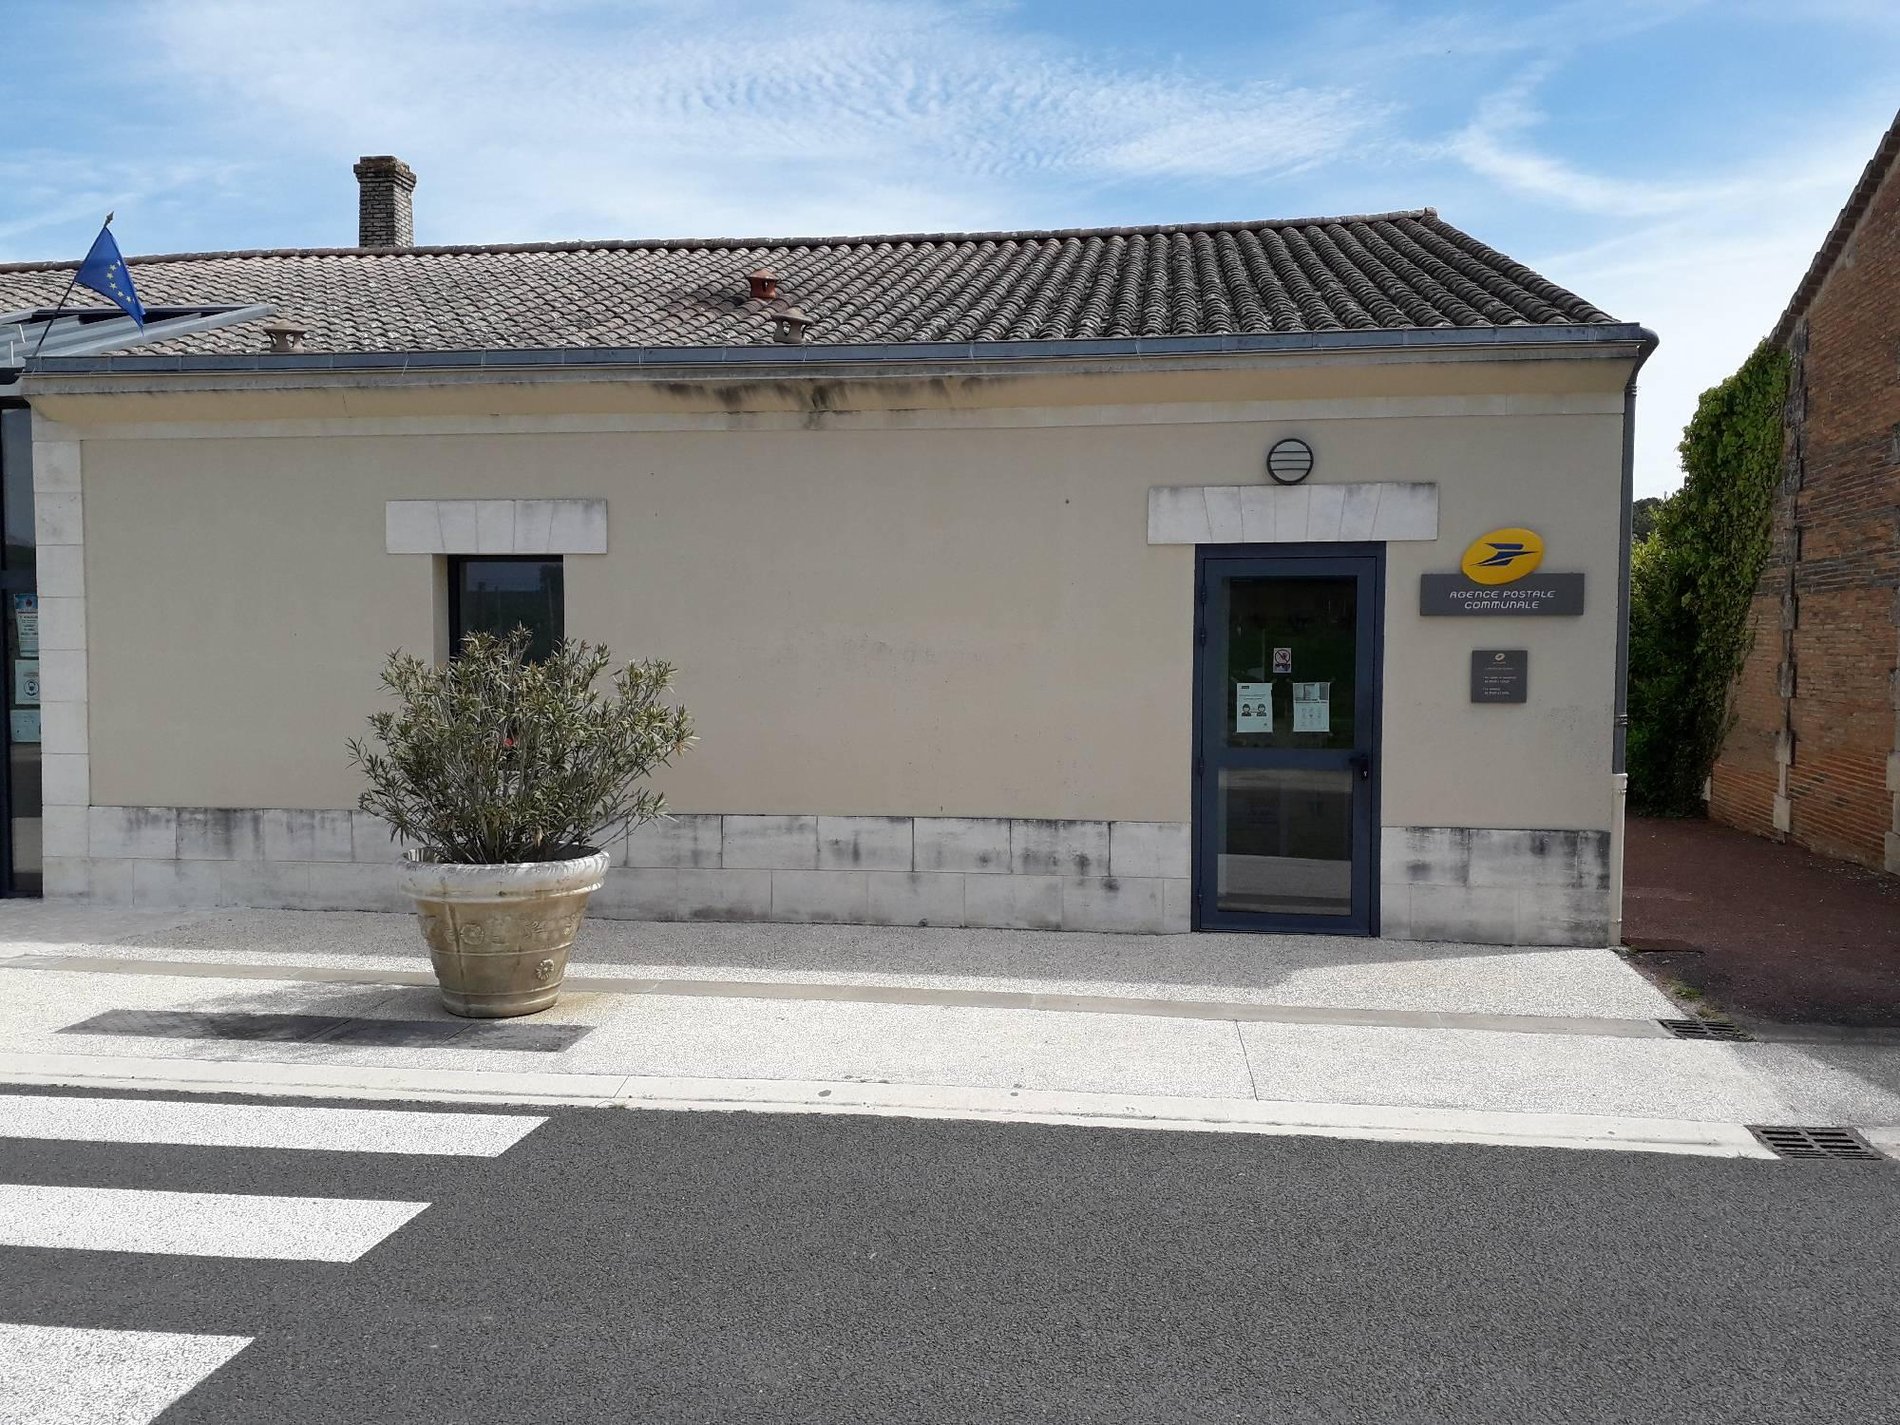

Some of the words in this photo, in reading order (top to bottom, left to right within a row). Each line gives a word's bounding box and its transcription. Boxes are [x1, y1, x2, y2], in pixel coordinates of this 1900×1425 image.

[1449, 590, 1499, 599] AGENCE
[1503, 590, 1556, 599] POSTALE
[1464, 600, 1540, 609] COMMUNALE
